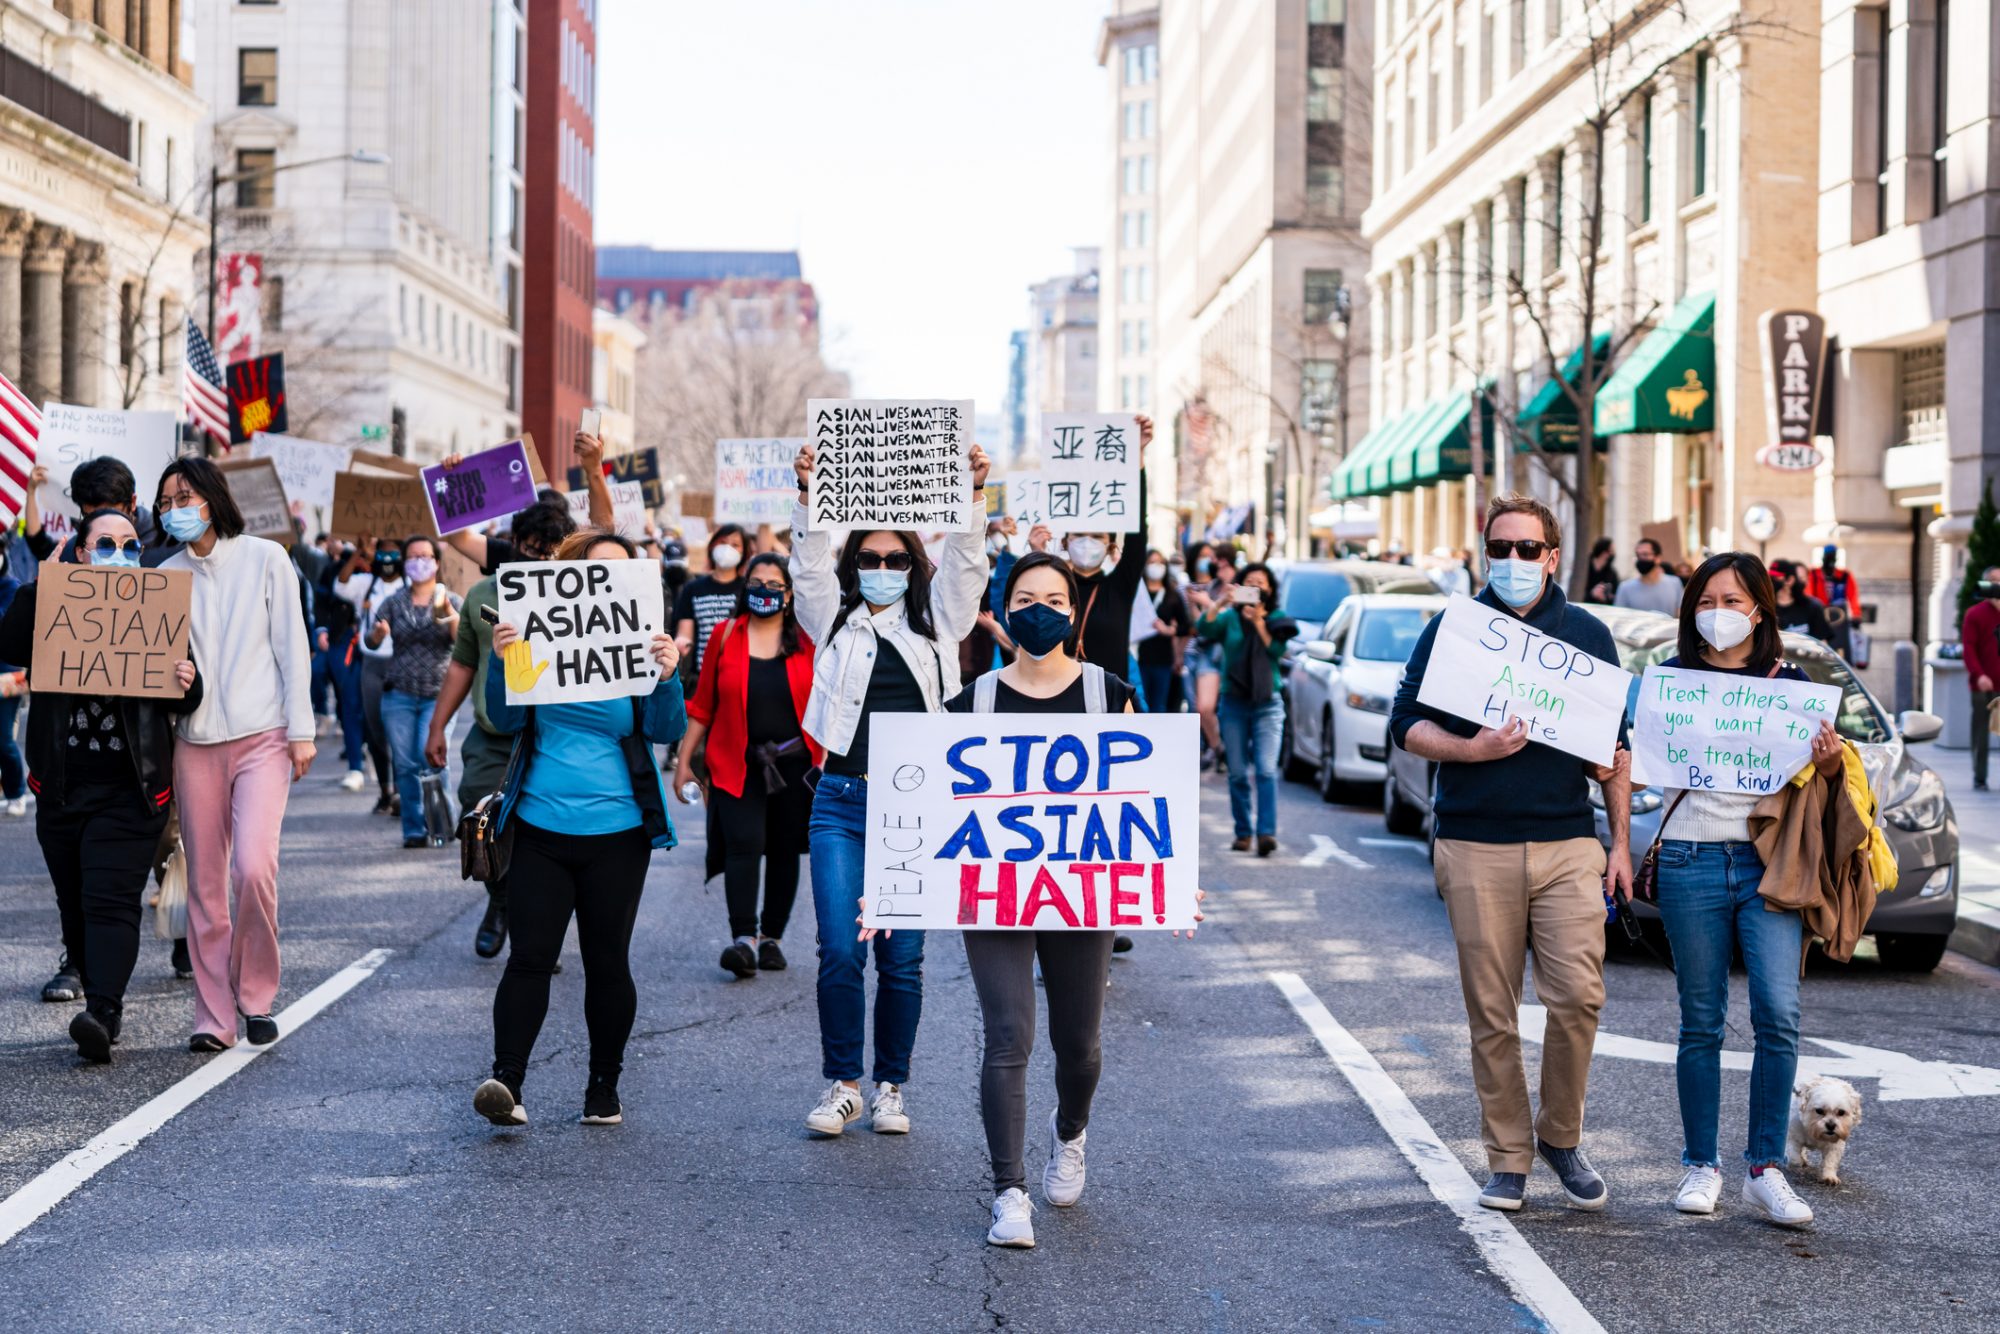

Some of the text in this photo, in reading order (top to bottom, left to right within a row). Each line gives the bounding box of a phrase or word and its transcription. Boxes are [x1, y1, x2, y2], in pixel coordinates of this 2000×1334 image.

[1783, 314, 1811, 421] PARK
[817, 407, 962, 423] ASIAN LIVES MATTER.
[817, 420, 962, 436] ASIAN LIVES MATTER.
[817, 444, 962, 465] ASIAN LIVES MATTER.
[818, 434, 960, 450] ASIAN LIVES MATTER.
[1052, 424, 1127, 463] 亚裔
[817, 462, 962, 480] ASIAN LIVES MATTER.
[817, 476, 962, 494] ASIAN LIVES MATTER.
[817, 492, 963, 508] ASIAN LIVES MATTER.
[818, 508, 961, 524] ASIAN LIVES MATTER.
[1048, 480, 1127, 519] 团结
[64, 569, 167, 604] STOP
[500, 565, 612, 601] STOP.
[748, 593, 779, 606] BIDEN
[44, 605, 186, 646] ASIAN
[524, 599, 651, 642] ASIAN.
[557, 643, 656, 687] HATE.
[1480, 618, 1594, 680] STOP
[59, 651, 165, 688] HATE
[1491, 665, 1565, 720] Asian
[1654, 675, 1827, 712] Treat others as
[1664, 712, 1810, 740] you want to
[946, 731, 1153, 795] STOP
[1667, 742, 1688, 764] be
[1689, 766, 1782, 792] Be kind!
[934, 797, 1173, 862] ASIAN
[876, 813, 922, 917] PEACE
[957, 862, 1165, 928] HATE!
